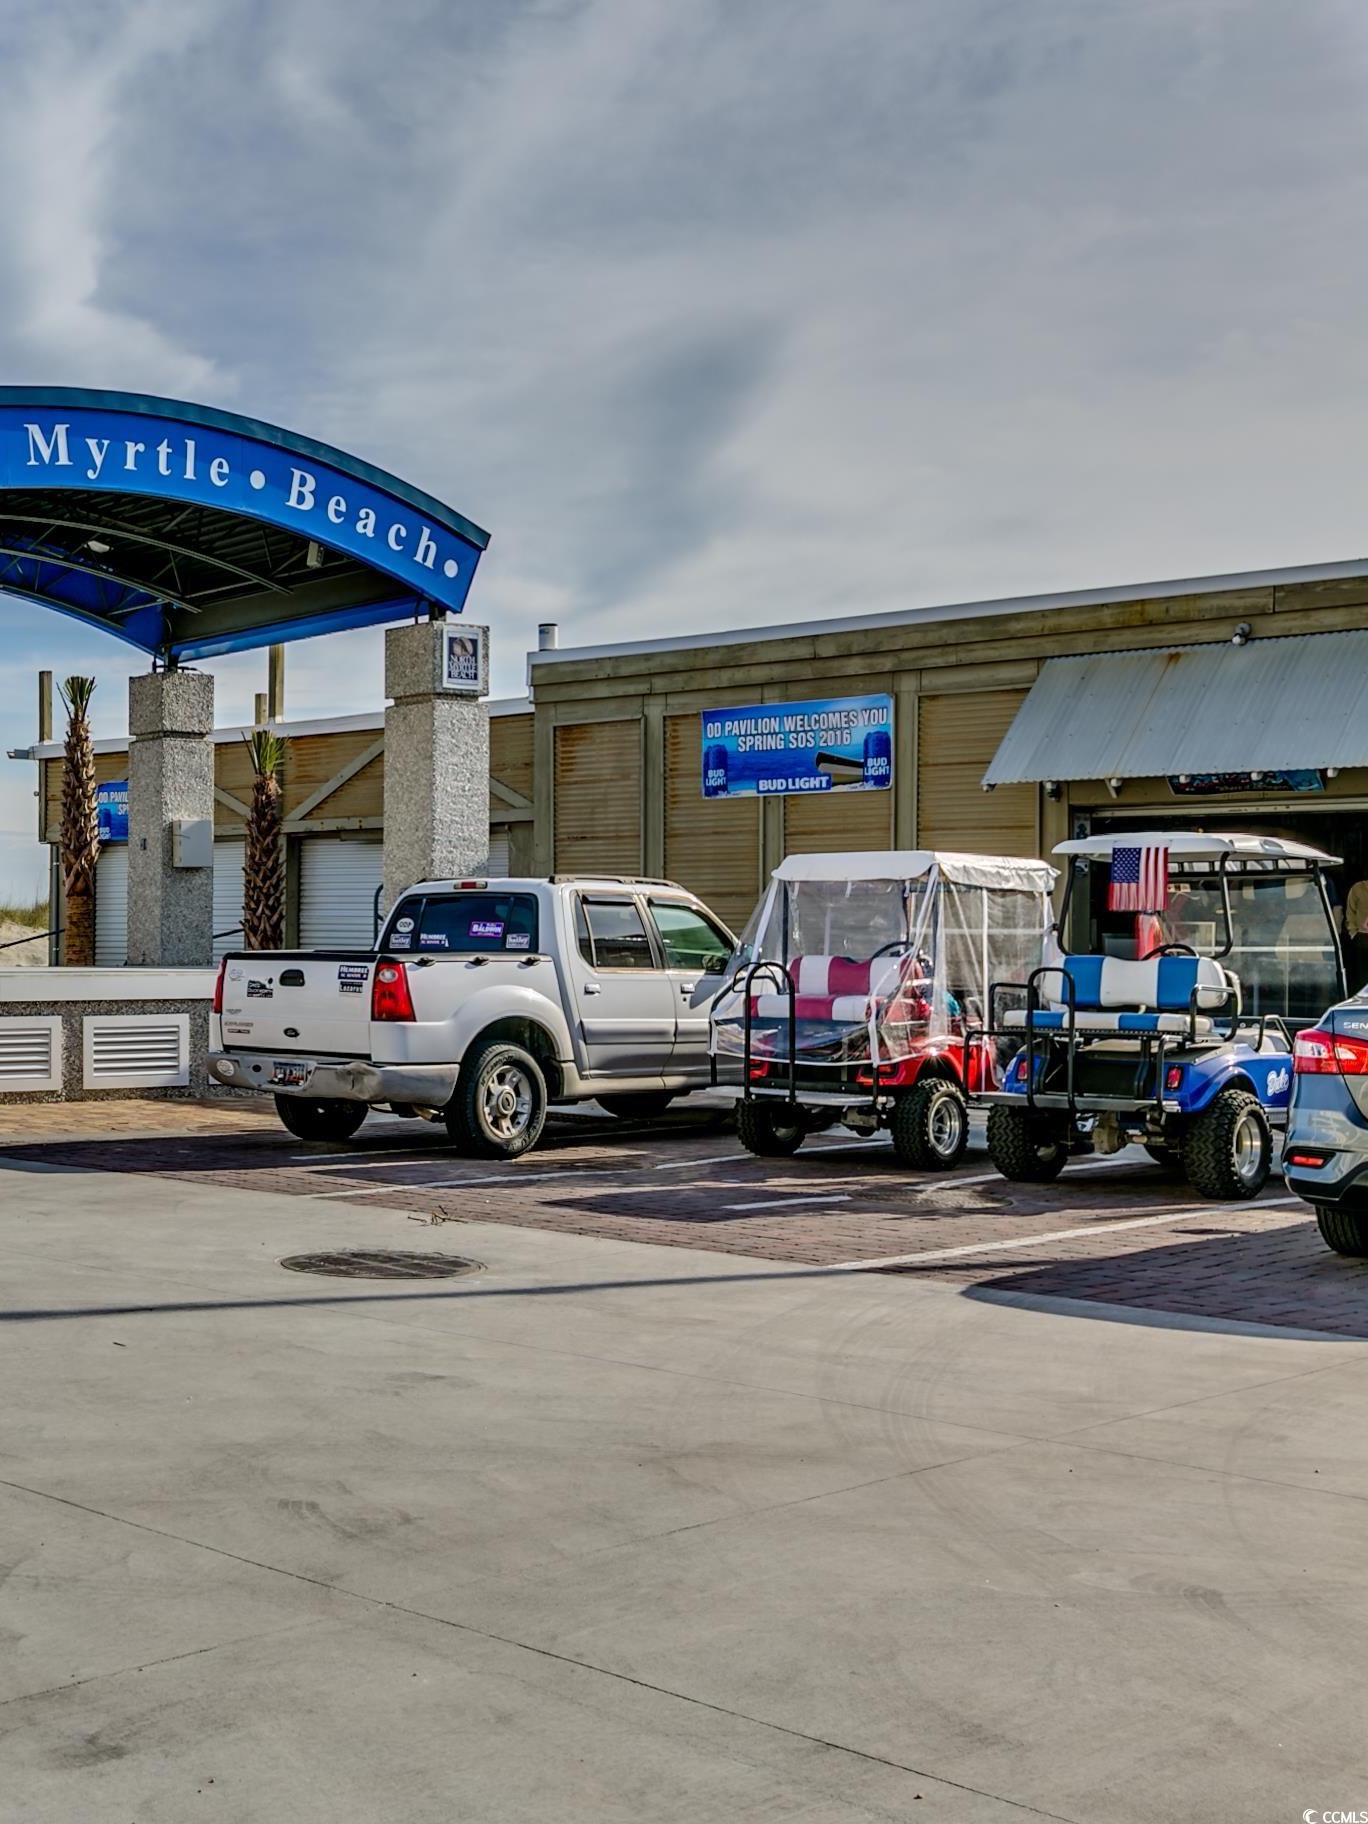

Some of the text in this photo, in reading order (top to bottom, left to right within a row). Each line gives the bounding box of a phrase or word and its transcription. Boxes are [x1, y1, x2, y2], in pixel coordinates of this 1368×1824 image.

[24, 423, 230, 486] Myrtle
[285, 467, 436, 571] Beach
[451, 670, 475, 679] BEACH
[706, 708, 888, 738] OD PAVILION WELCOMES YOU
[738, 729, 851, 752] SPRING SOS 2016
[867, 757, 888, 767] BUD
[708, 769, 725, 778] BUD
[864, 765, 890, 776] LIGHT
[705, 776, 727, 786] LIGHT
[758, 776, 830, 791] BUD LIGHT
